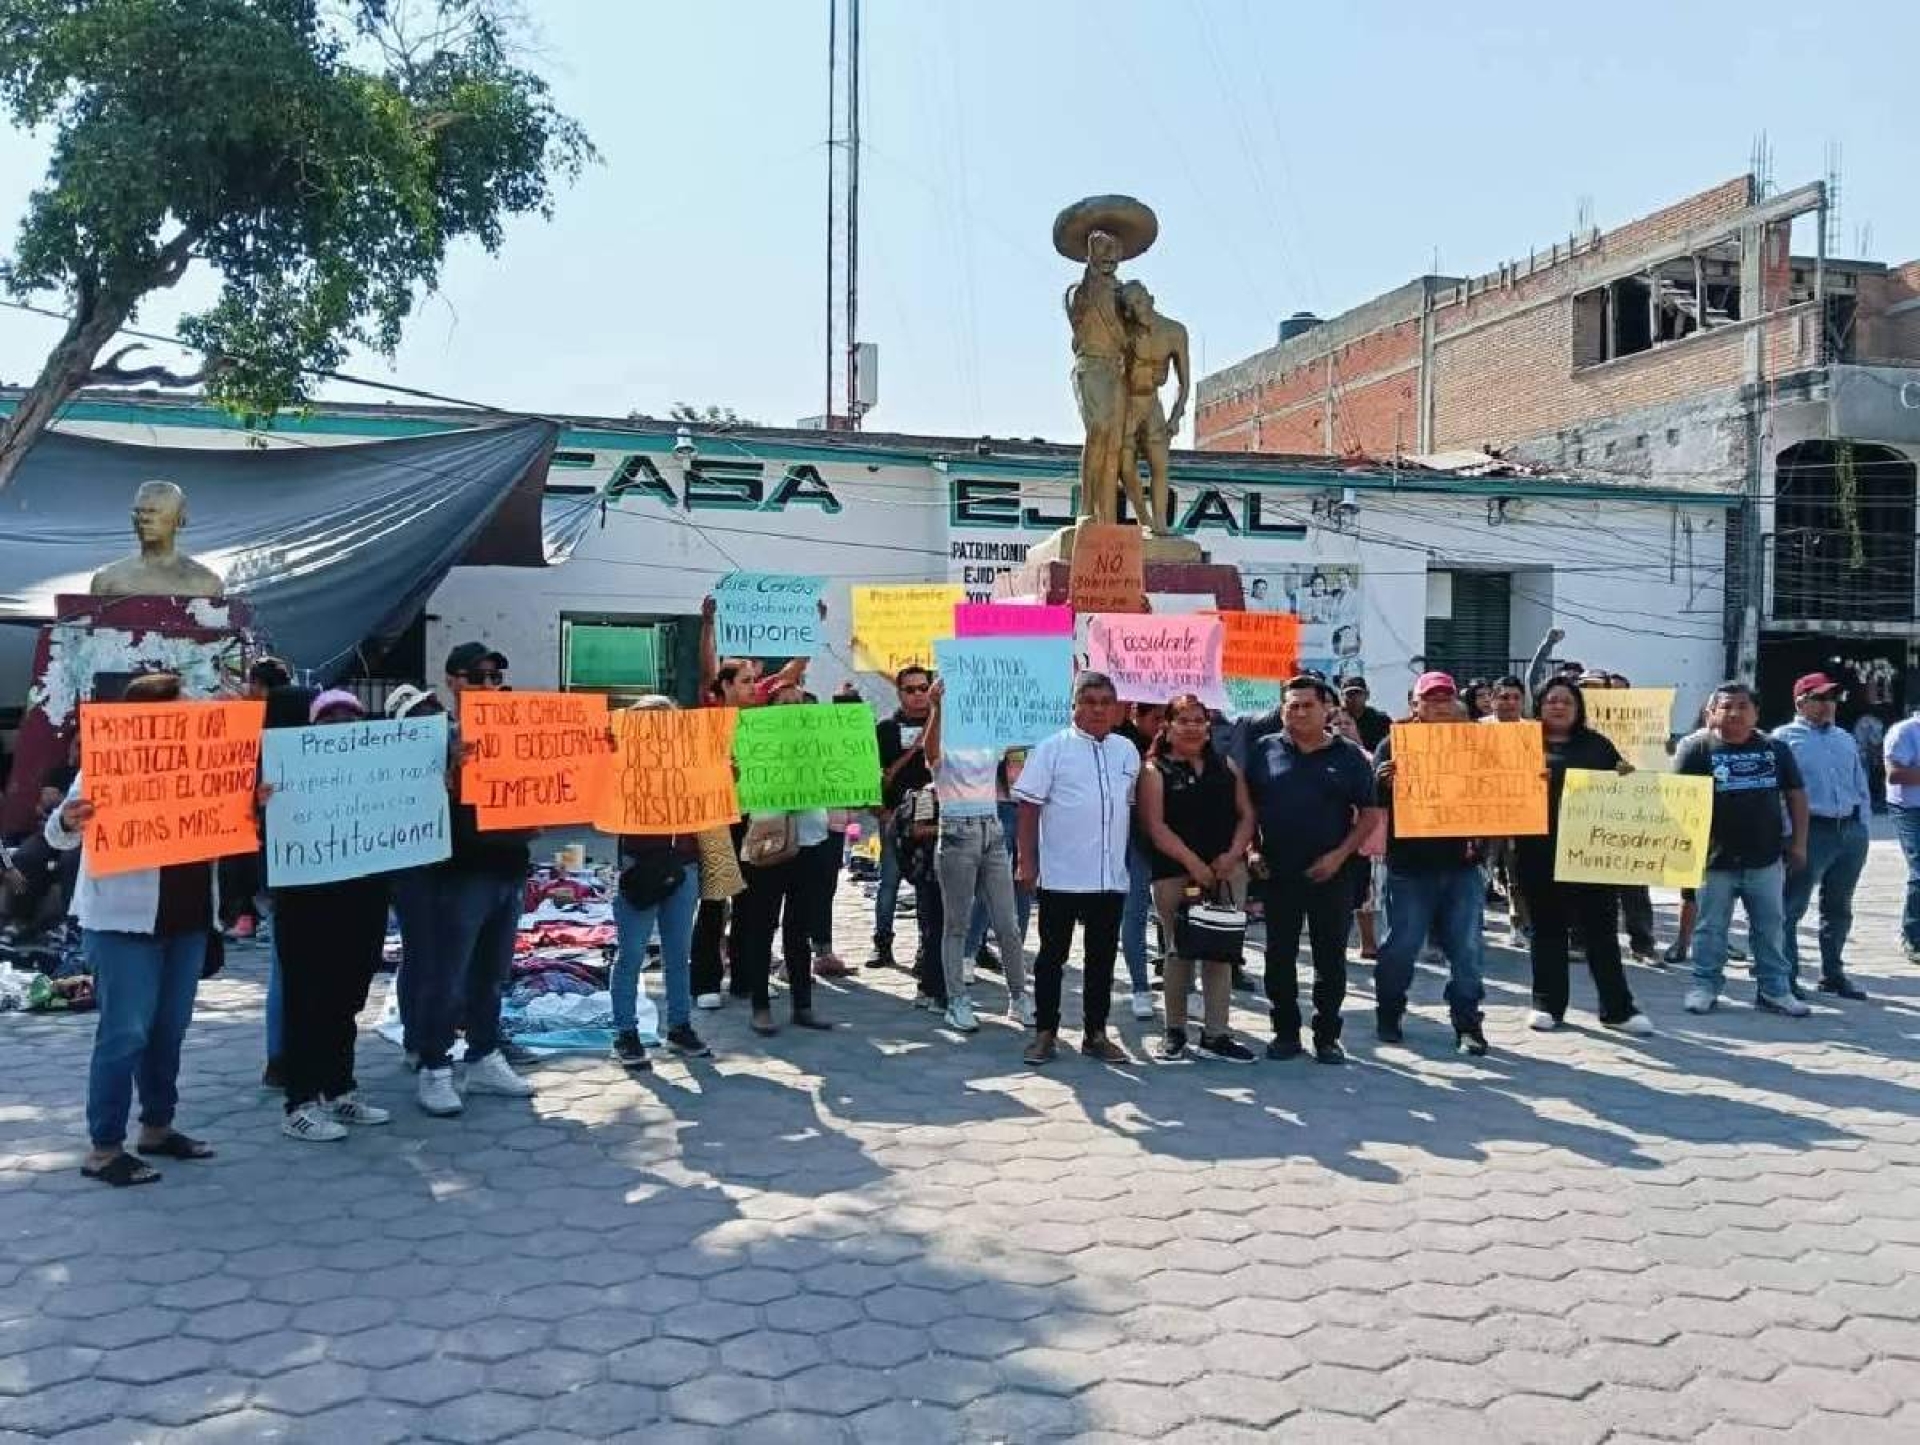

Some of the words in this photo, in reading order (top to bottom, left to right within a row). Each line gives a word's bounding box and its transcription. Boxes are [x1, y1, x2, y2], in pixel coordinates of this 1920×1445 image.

[1095, 552, 1123, 574] NO
[175, 775, 195, 799] EL
[95, 823, 109, 852] A
